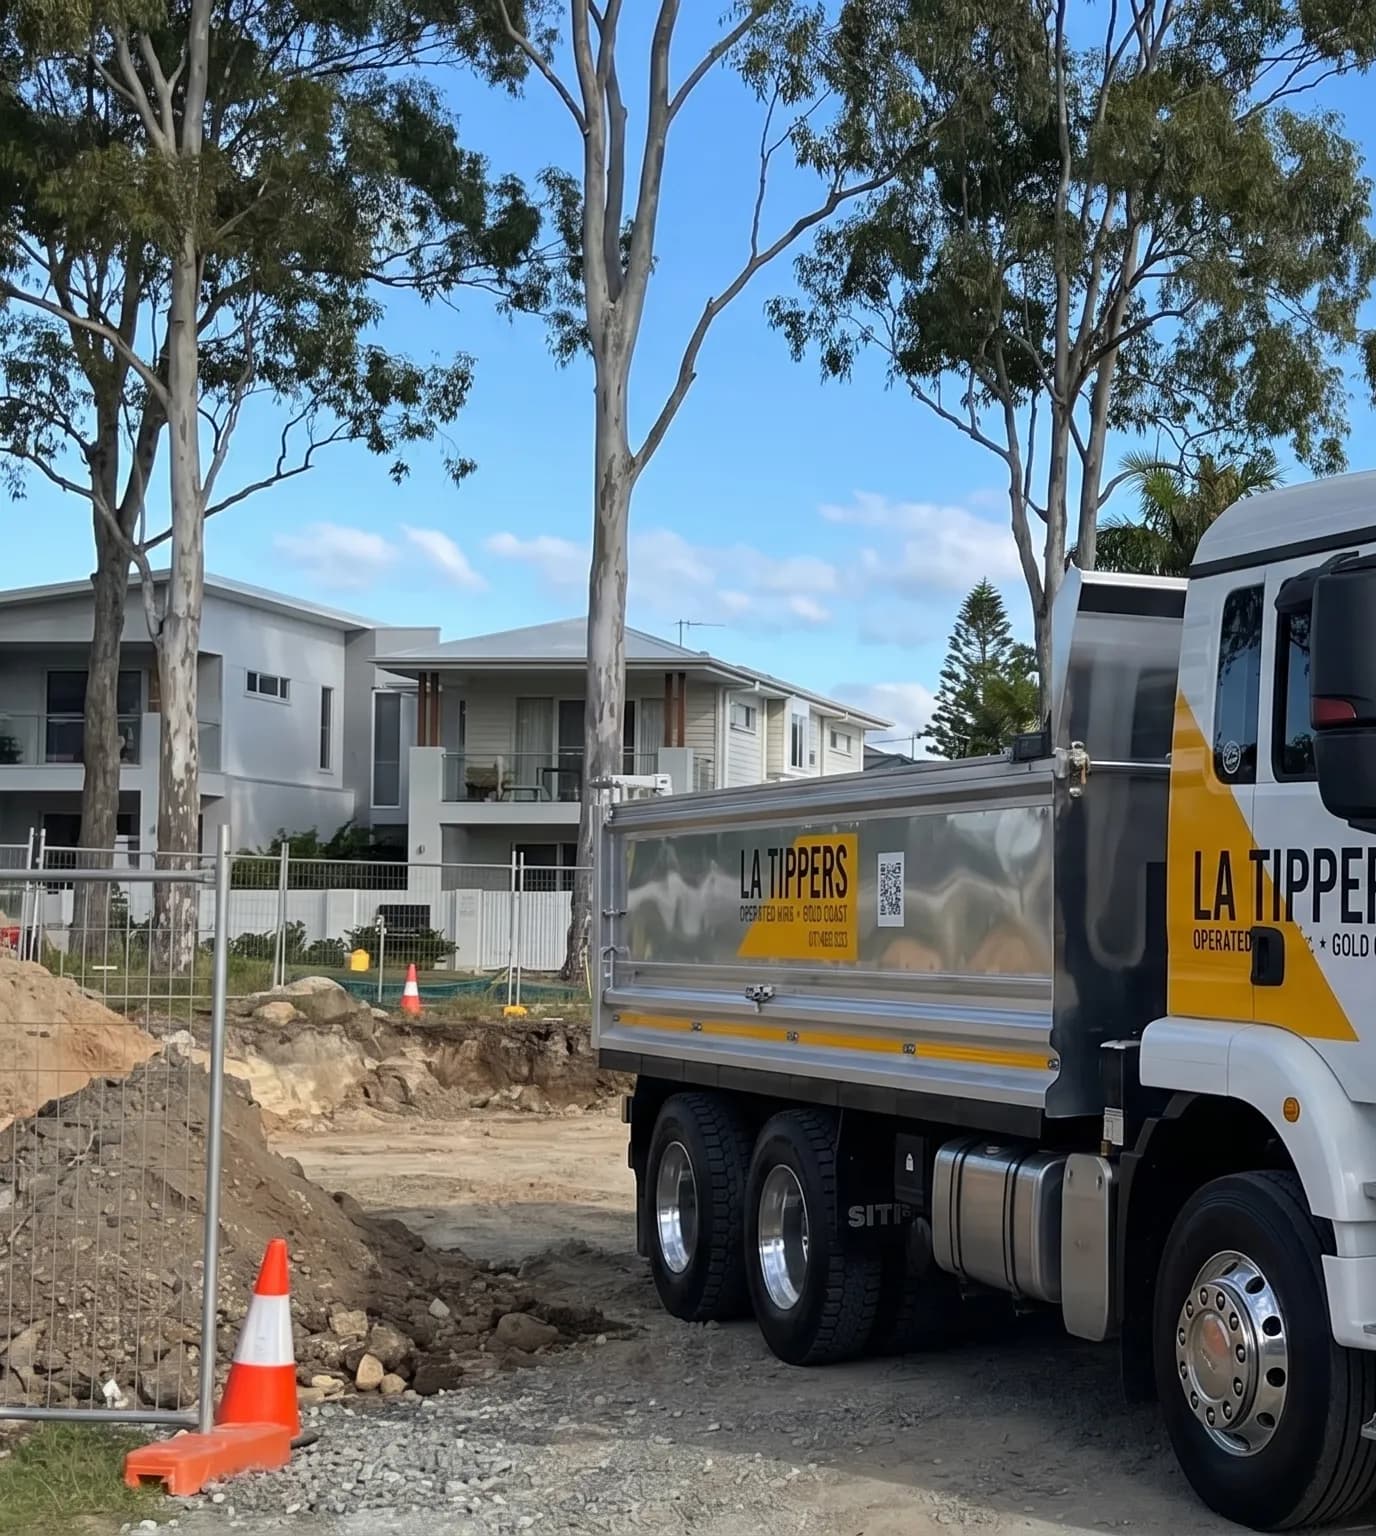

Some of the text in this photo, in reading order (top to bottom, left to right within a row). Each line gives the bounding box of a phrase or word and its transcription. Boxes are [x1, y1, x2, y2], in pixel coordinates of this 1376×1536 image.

[741, 844, 848, 899] LA TIPPERS
[1194, 850, 1236, 921] LA
[824, 904, 848, 923] COAST
[1193, 929, 1251, 952] OPERATED
[1332, 933, 1369, 958] GOLD
